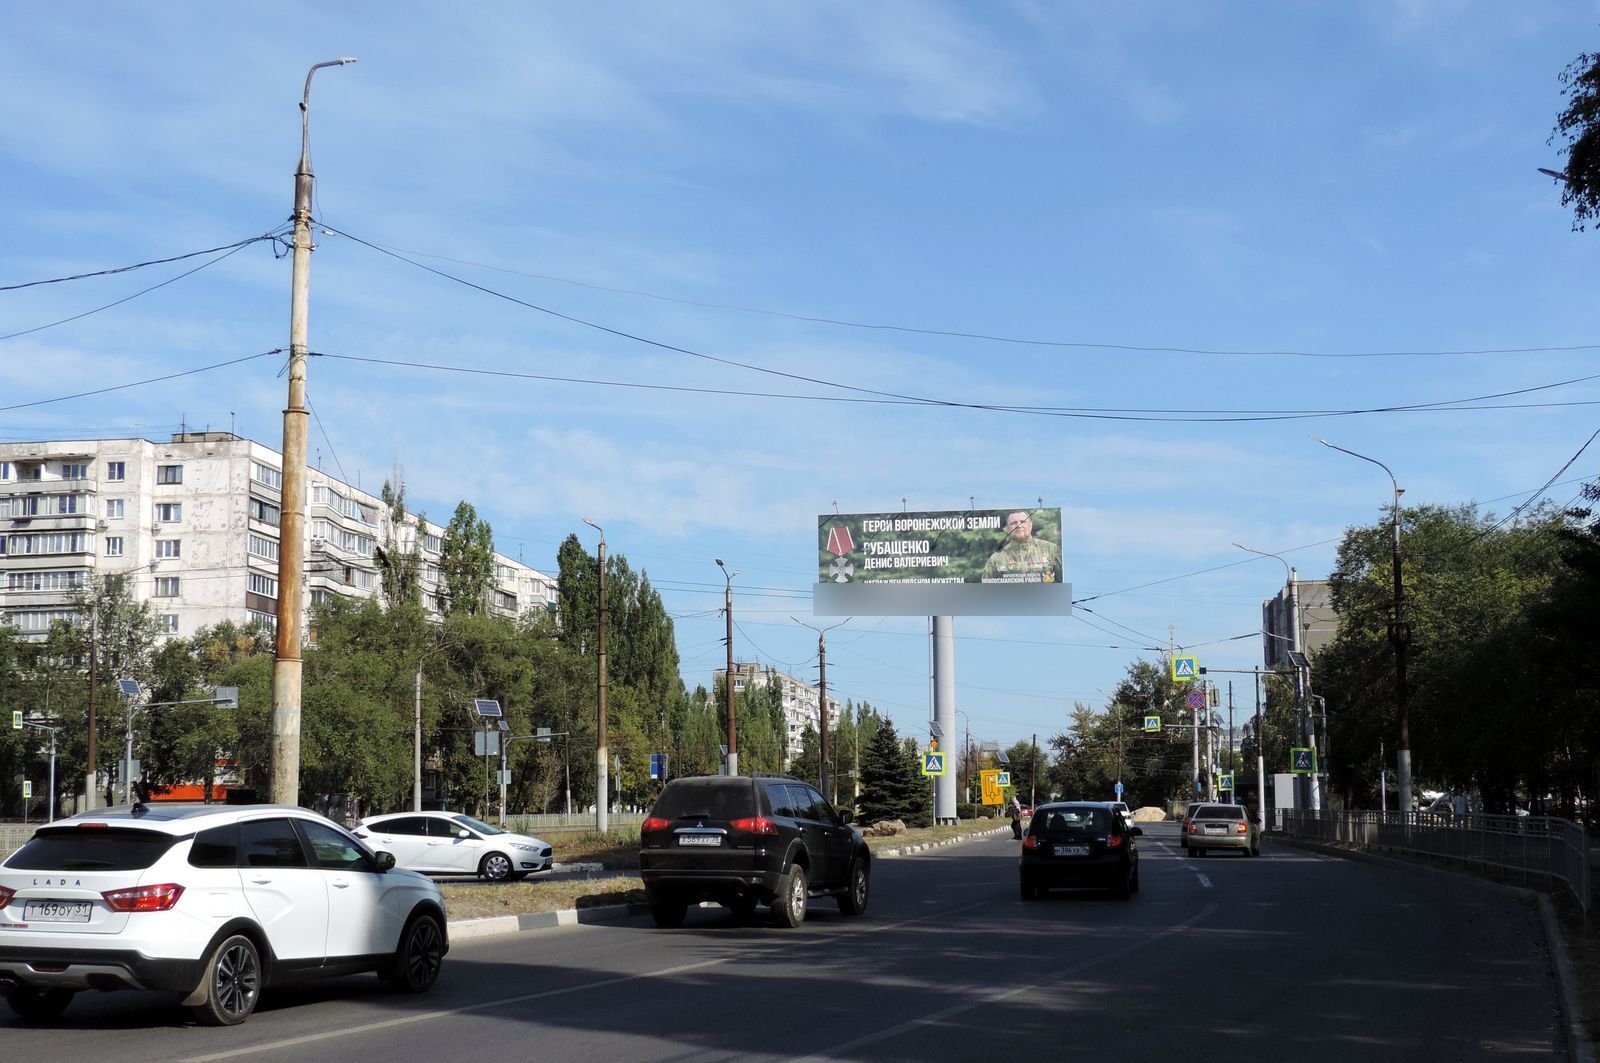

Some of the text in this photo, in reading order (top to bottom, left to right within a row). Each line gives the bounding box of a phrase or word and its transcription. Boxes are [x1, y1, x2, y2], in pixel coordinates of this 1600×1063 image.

[895, 516, 965, 531] ВОРОНЕЖСКОЙ
[967, 517, 1001, 529] ЗЕМЛИ
[864, 555, 949, 569] ДЕНИС ВАЛЕРИЕВИЧ
[75, 903, 88, 914] 31
